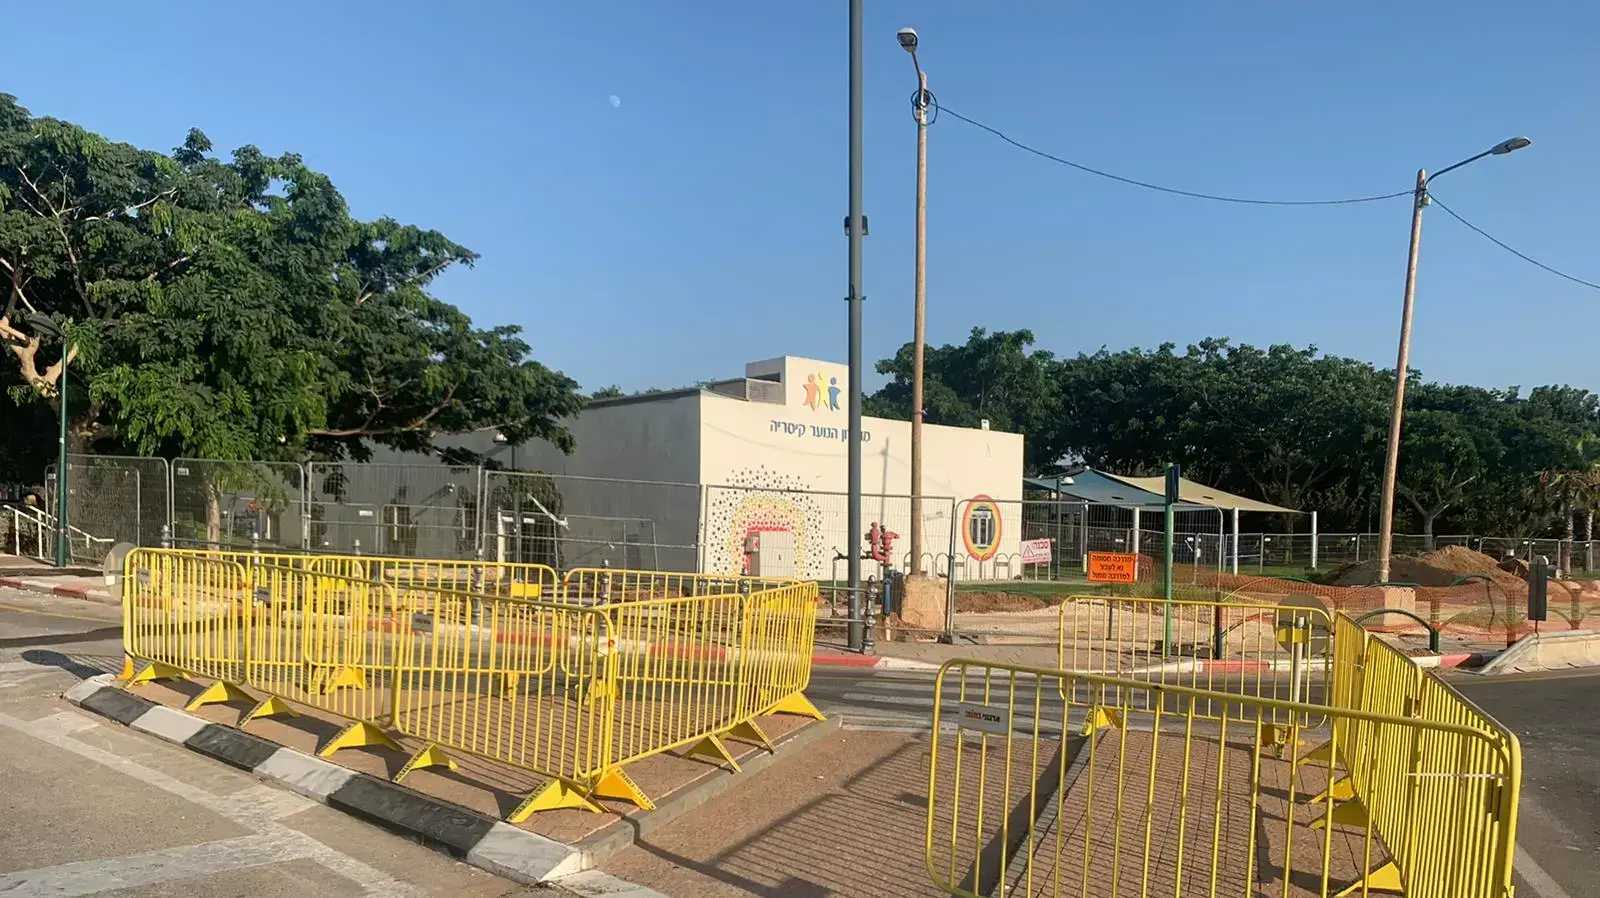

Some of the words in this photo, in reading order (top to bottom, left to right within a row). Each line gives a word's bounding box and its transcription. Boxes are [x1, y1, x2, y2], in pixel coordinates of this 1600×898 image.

[769, 419, 806, 438] קיסריה
[809, 424, 838, 440] הנוער
[1092, 554, 1112, 562] חסומה
[1112, 555, 1132, 563] מדרכה
[1108, 572, 1130, 580] למדרכה
